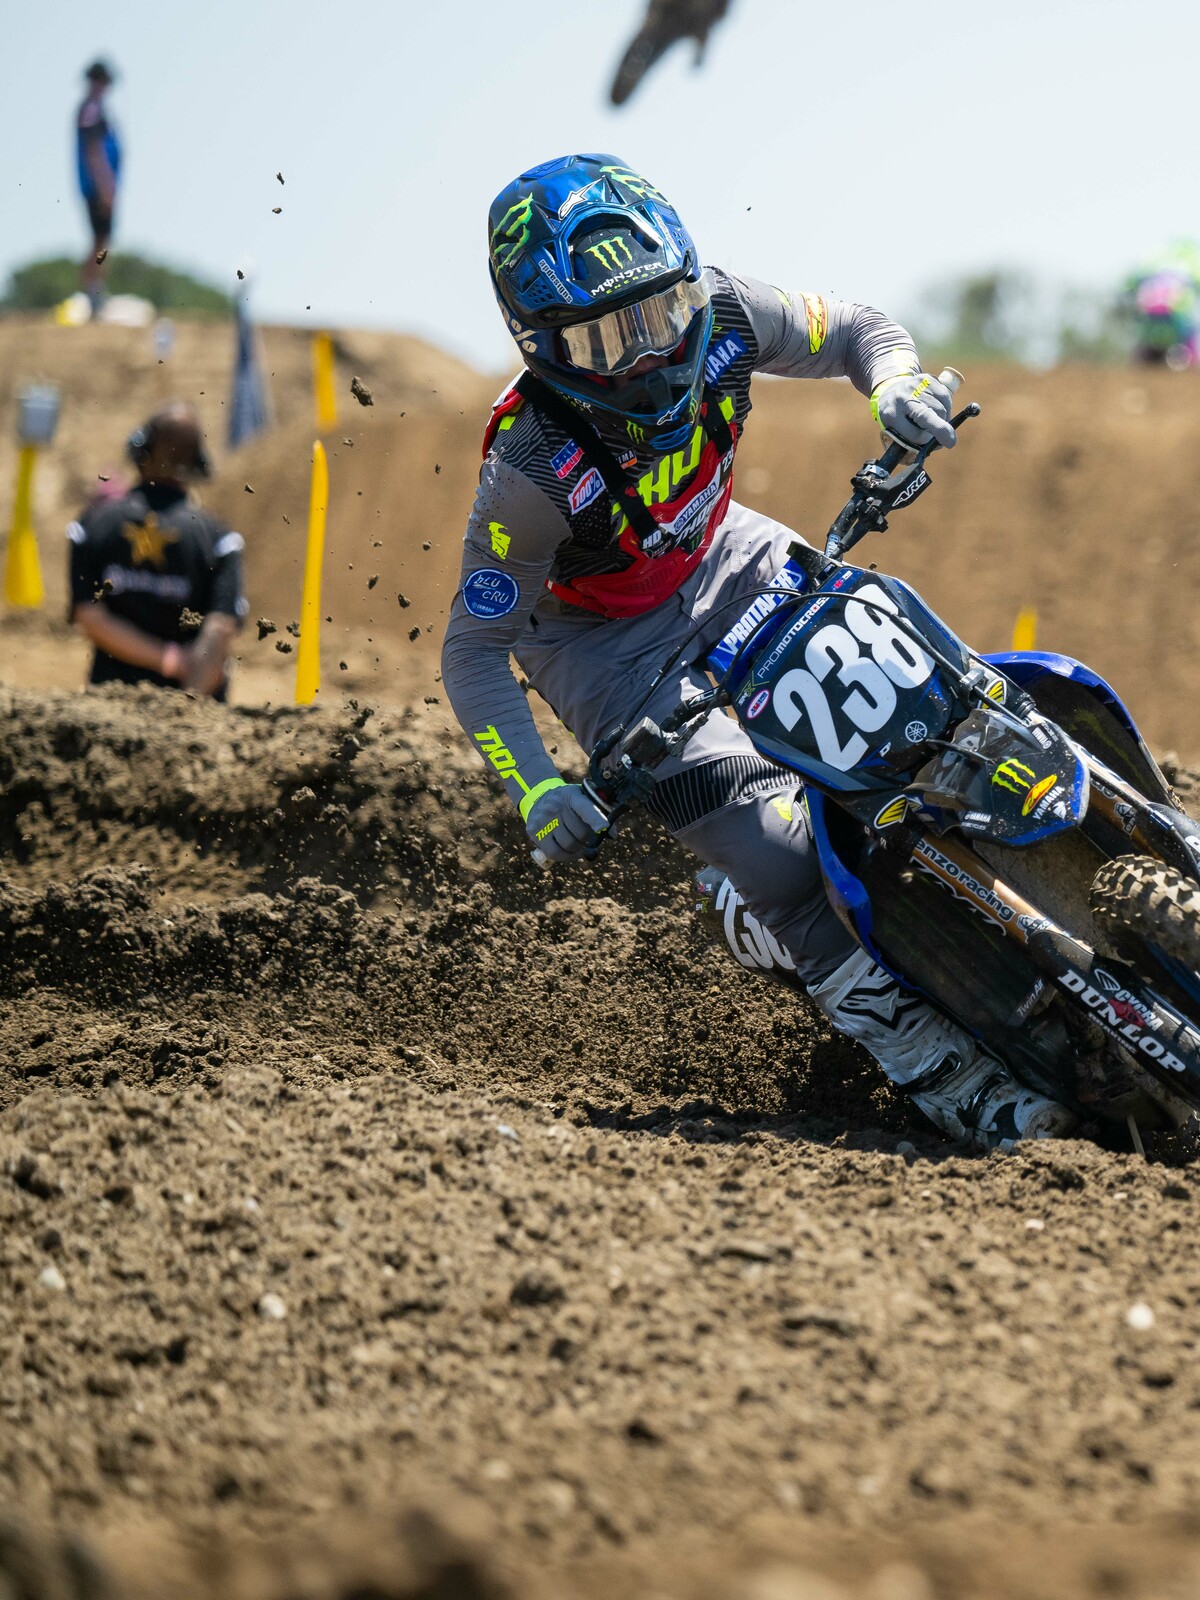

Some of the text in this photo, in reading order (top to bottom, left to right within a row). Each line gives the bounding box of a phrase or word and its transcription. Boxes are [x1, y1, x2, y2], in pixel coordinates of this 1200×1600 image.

[538, 259, 574, 304] apdesigns
[590, 261, 667, 296] MONSTER
[574, 474, 601, 508] 100%
[682, 481, 718, 523] YAMAHA
[892, 470, 927, 507] ARC
[642, 529, 662, 550] HD
[722, 570, 797, 656] PROTAPER
[772, 583, 935, 772] 238
[1032, 786, 1066, 820] YAMAHA
[535, 818, 560, 842] THOR
[1016, 977, 1045, 1018] Twin Air
[1115, 989, 1165, 1032] CYCRA
[1057, 969, 1187, 1073] DUNLOP
